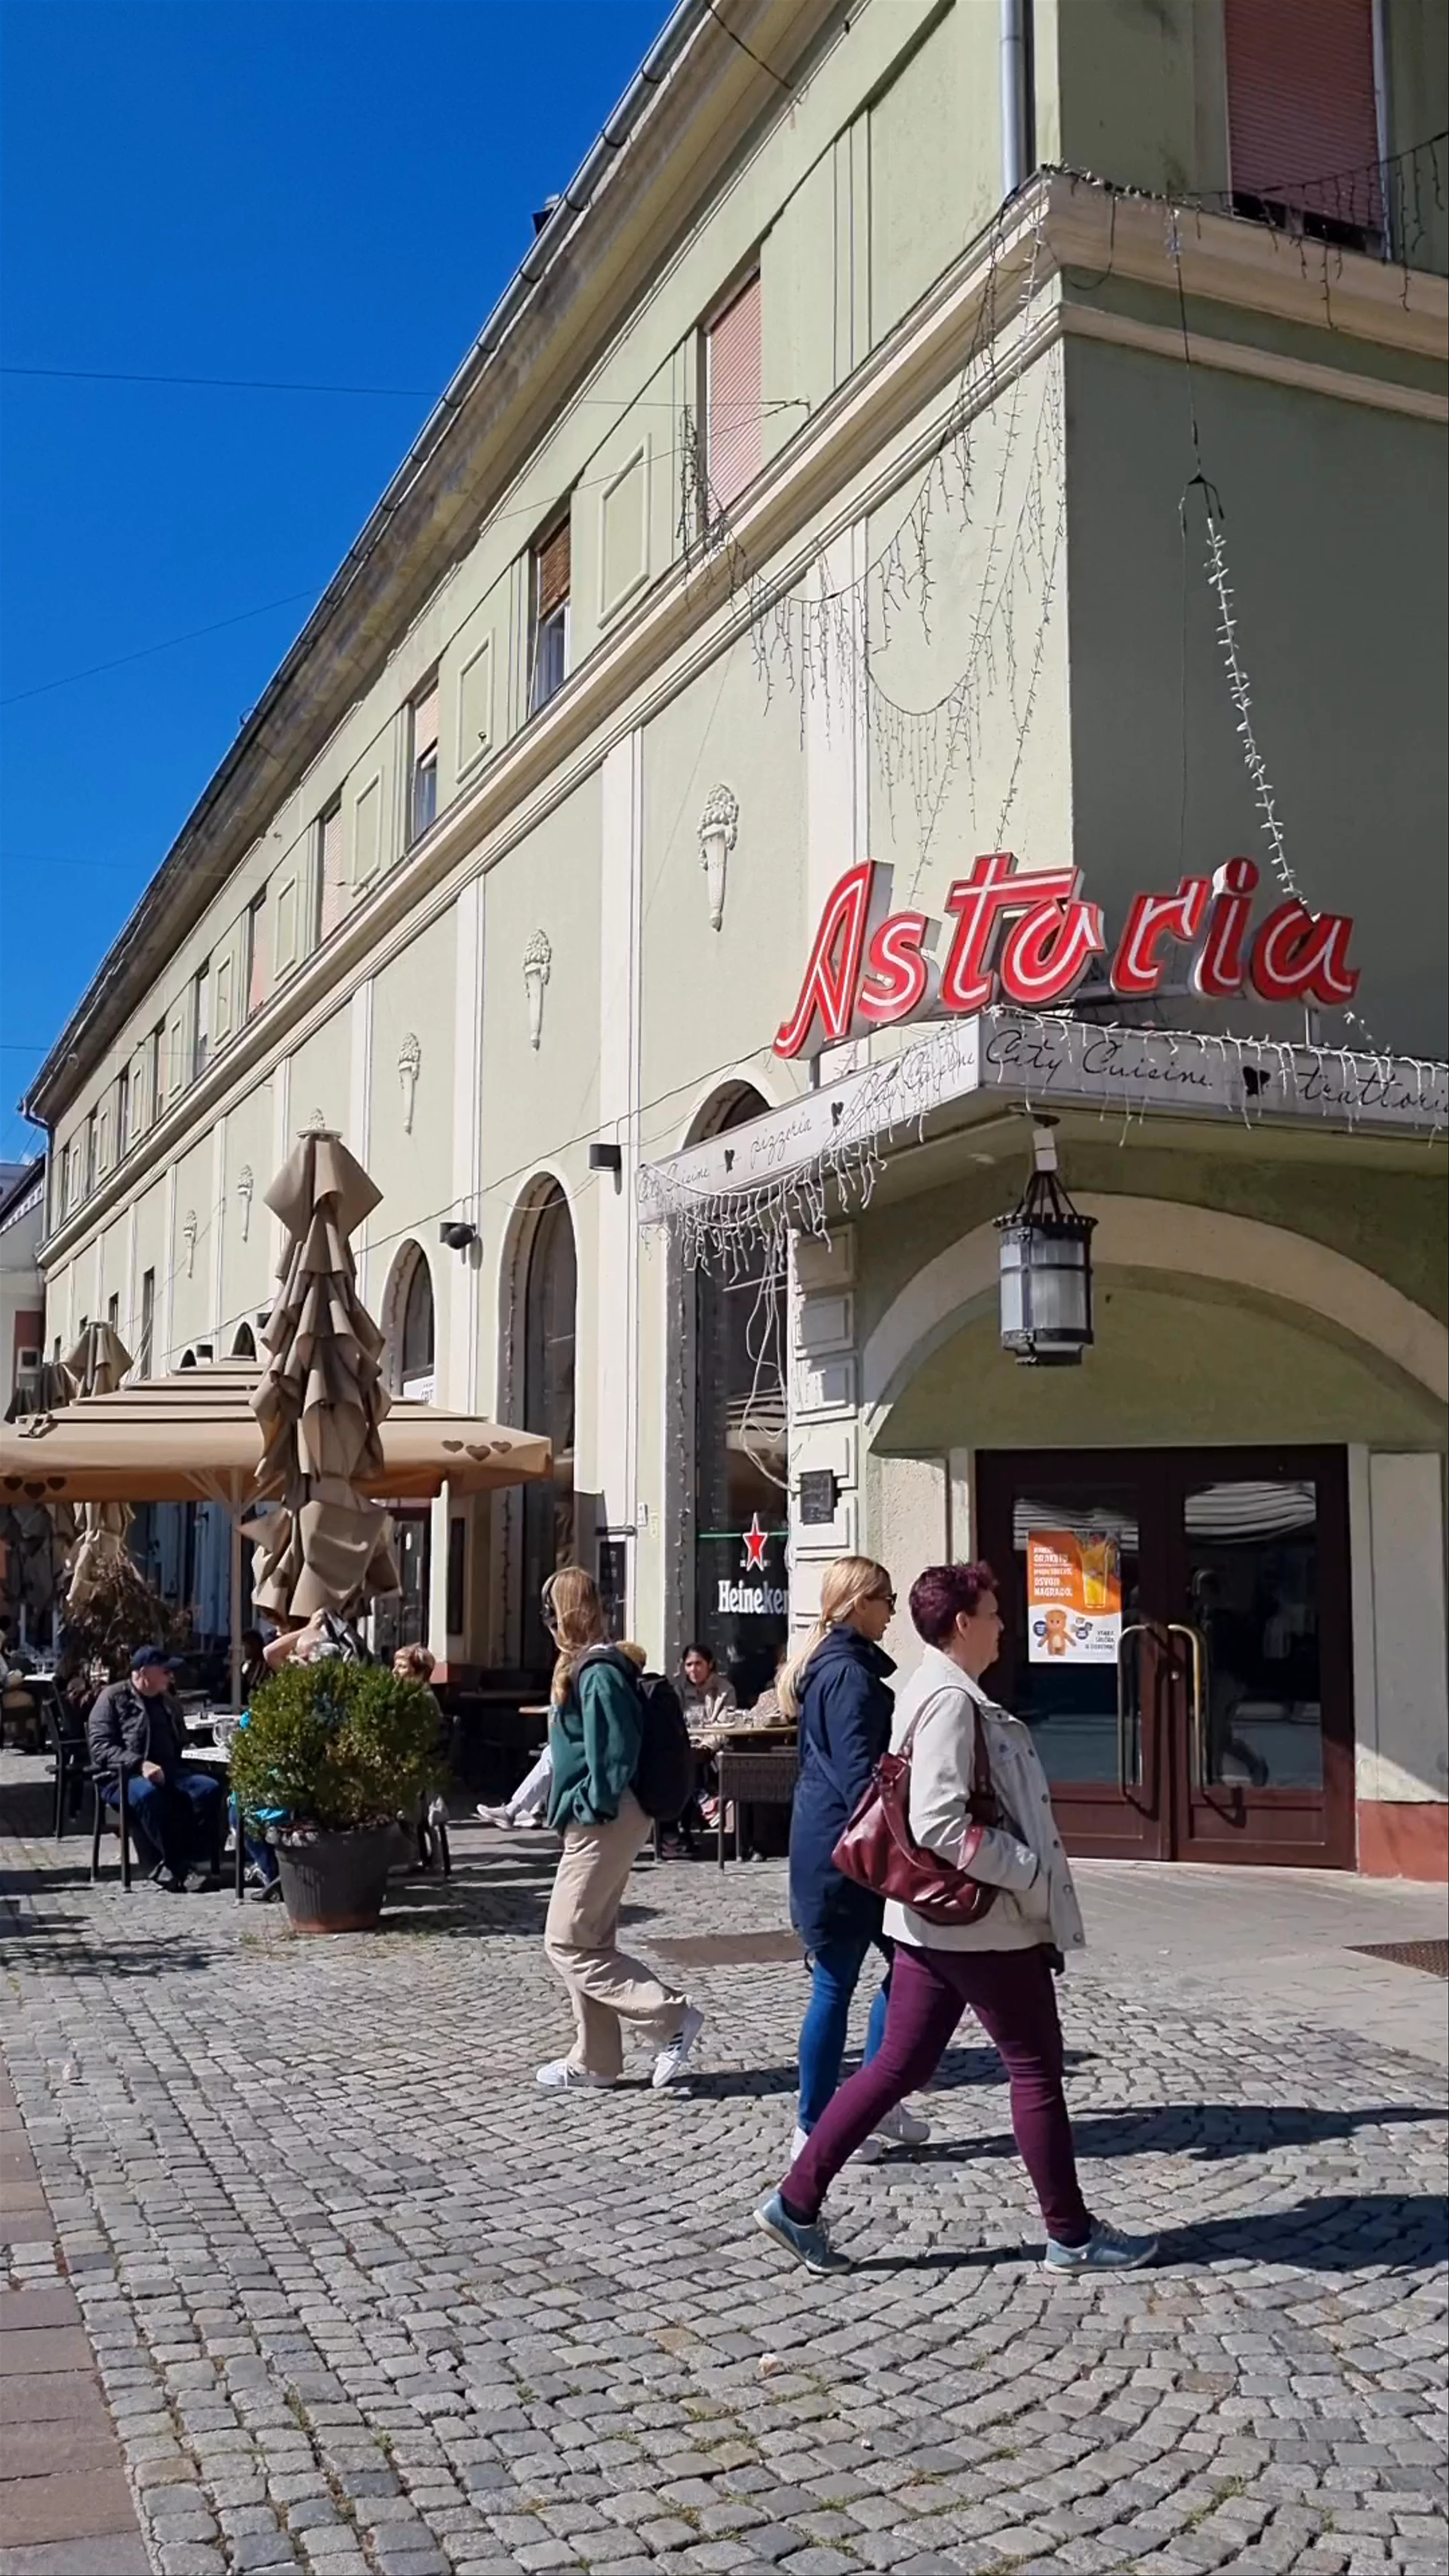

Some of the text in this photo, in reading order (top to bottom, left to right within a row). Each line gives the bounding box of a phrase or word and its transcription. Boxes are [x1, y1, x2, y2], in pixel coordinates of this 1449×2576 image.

[774, 852, 1360, 1058] Astoria
[986, 1029, 1214, 1086] City Cuisine
[666, 1162, 710, 1192] Cisine
